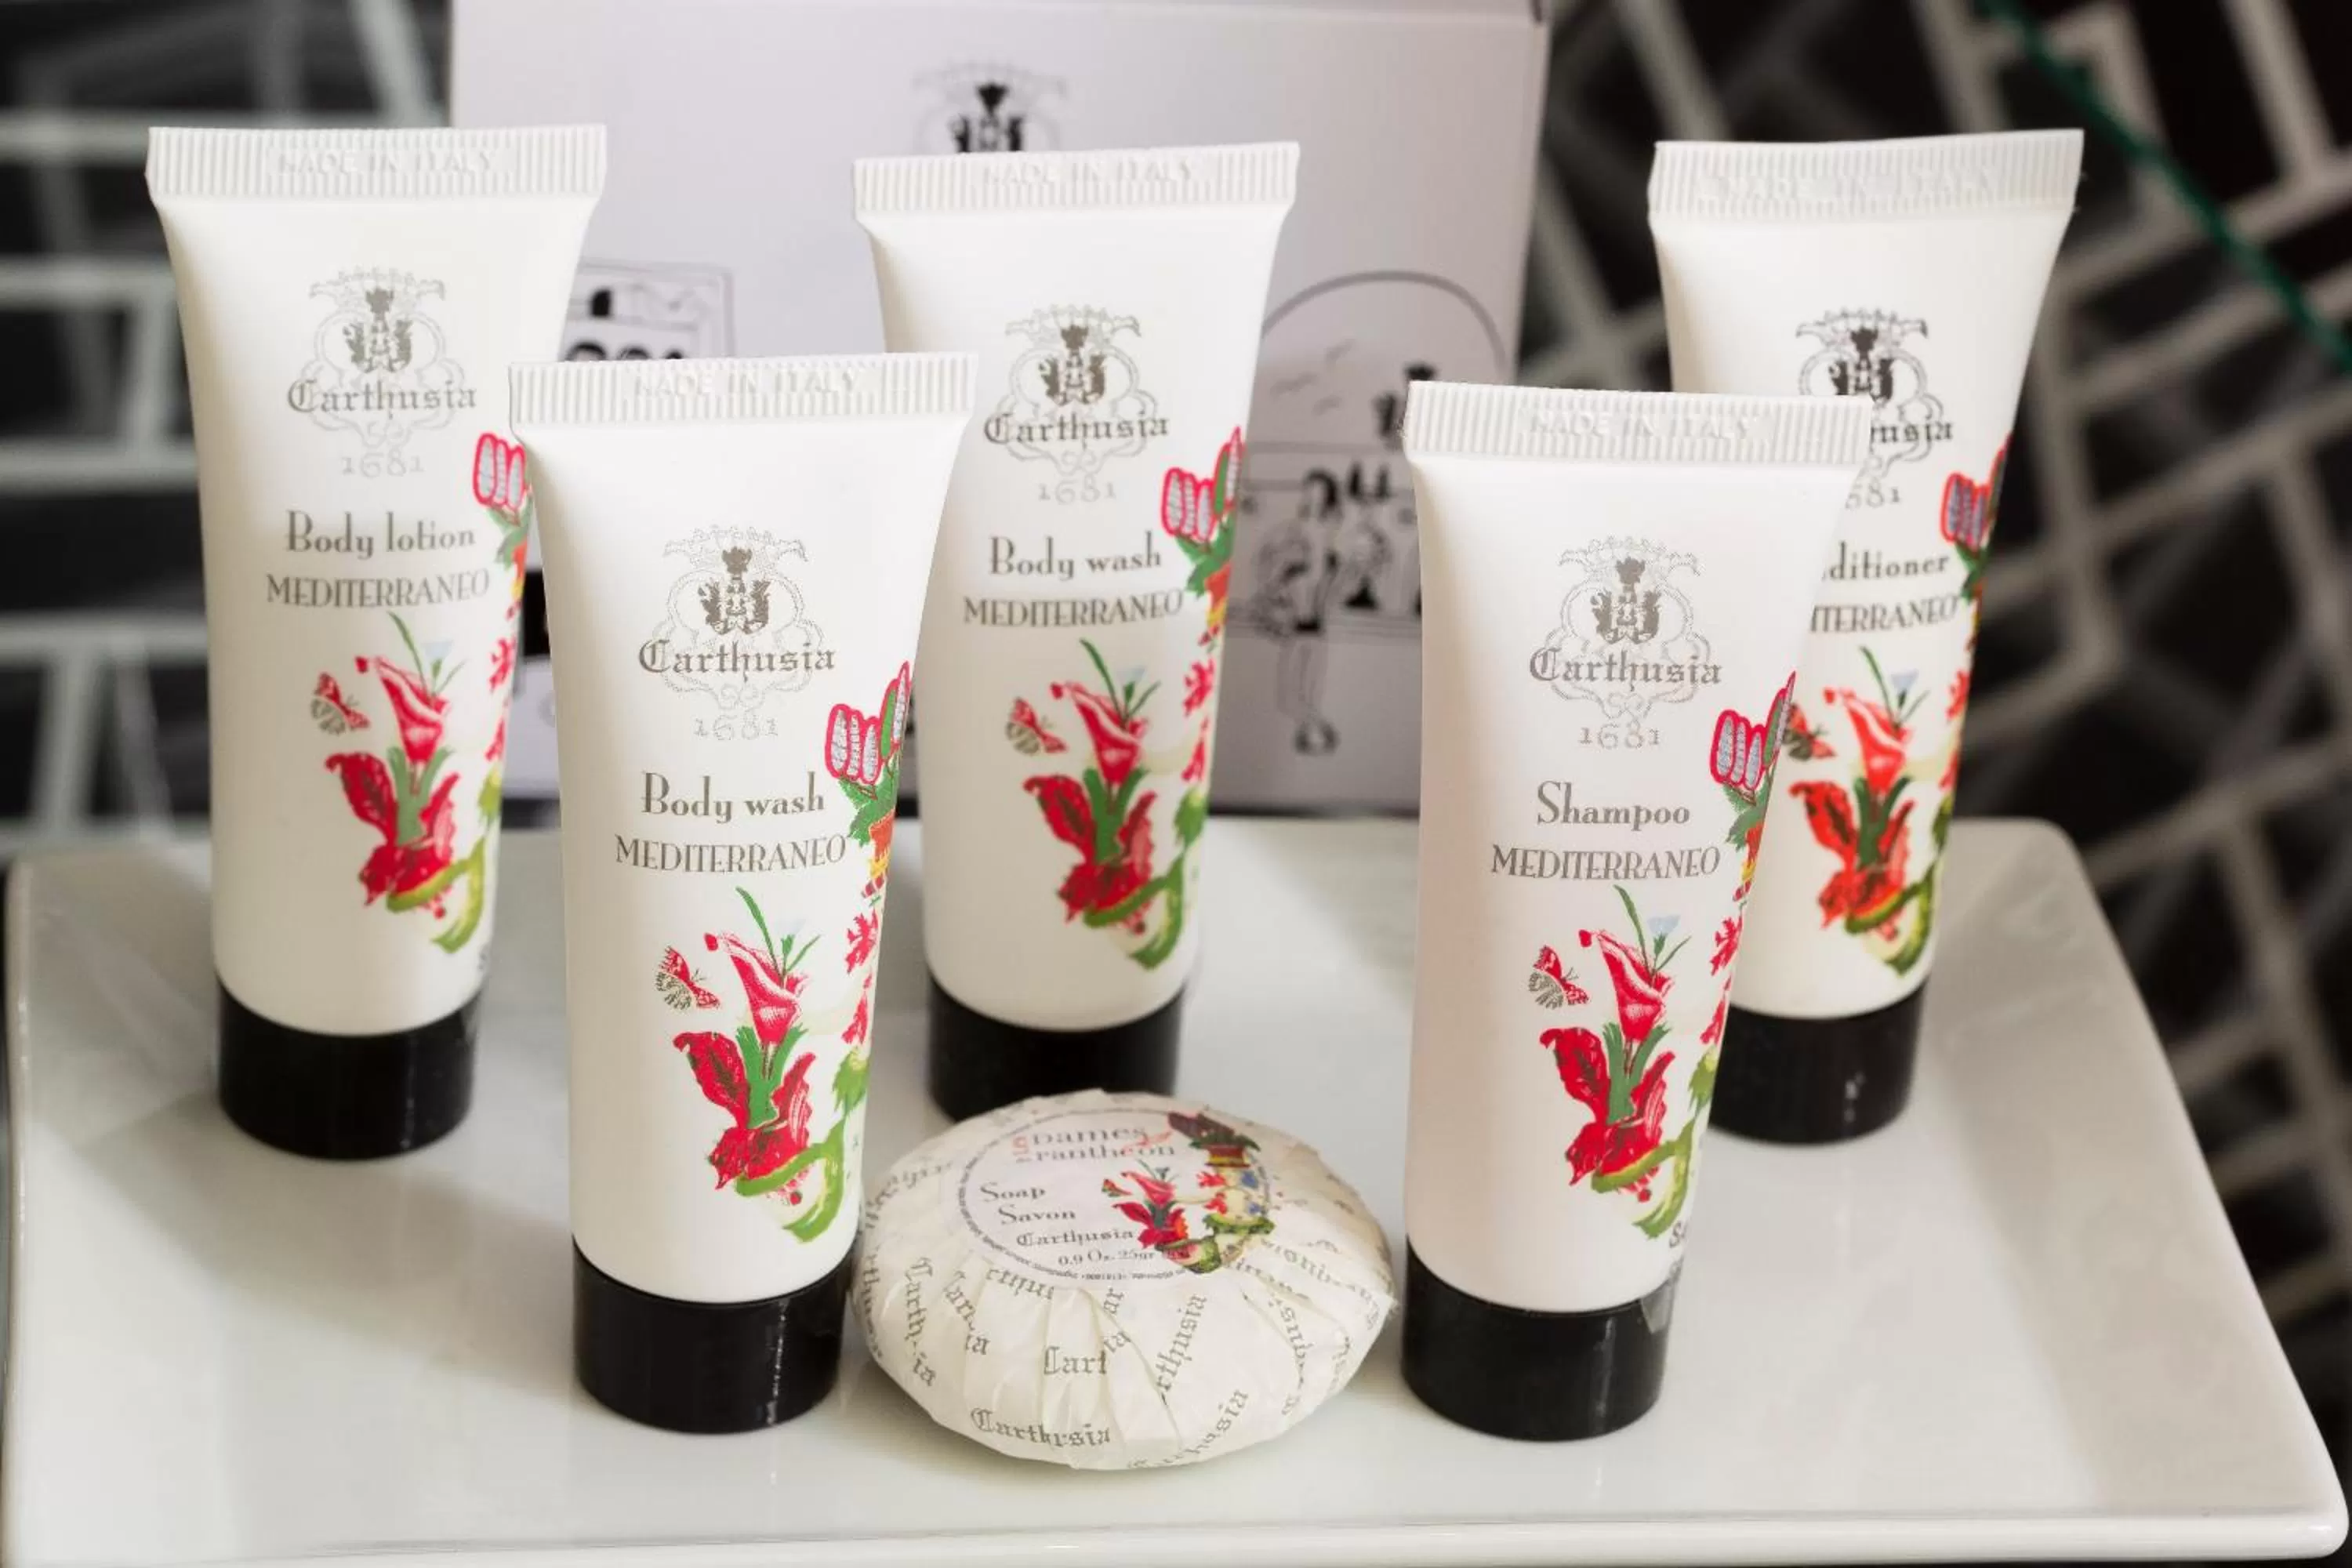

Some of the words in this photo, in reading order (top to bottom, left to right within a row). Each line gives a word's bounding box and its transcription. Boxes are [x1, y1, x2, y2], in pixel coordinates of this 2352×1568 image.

[287, 379, 477, 419] Carthusia
[633, 371, 713, 397] MADE
[728, 370, 757, 395] IN
[774, 368, 858, 394] ITALY
[984, 412, 1170, 451] Carthusia
[1530, 412, 1611, 437] MADE
[1623, 413, 1655, 437] IN
[1671, 415, 1753, 440] ITALY
[340, 444, 425, 478] 1681
[1038, 473, 1116, 505] 1681
[1845, 475, 1900, 511] 681
[285, 510, 374, 561] Body
[386, 510, 475, 552] lotion
[989, 535, 1075, 581] Body
[1085, 530, 1161, 573] wash
[1823, 540, 1950, 582] ditioner
[266, 568, 490, 608] MEDITERRANEO
[963, 588, 1185, 628] MEDITERRANEO
[1810, 593, 1960, 633] ITERRANEO
[638, 638, 836, 682] Carthusia
[1530, 648, 1722, 692] Carthusia
[693, 707, 779, 741] 1681
[1577, 718, 1661, 750] 1681
[641, 771, 732, 824] Body
[743, 771, 824, 817] wash
[1537, 780, 1690, 832] Shampoo
[614, 833, 848, 873] MEDITERRANEO
[1490, 844, 1721, 880] MEDITERRANEO
[979, 1181, 1047, 1203] Soap
[997, 1203, 1077, 1225] Savon
[1016, 1229, 1134, 1247] Carthusia
